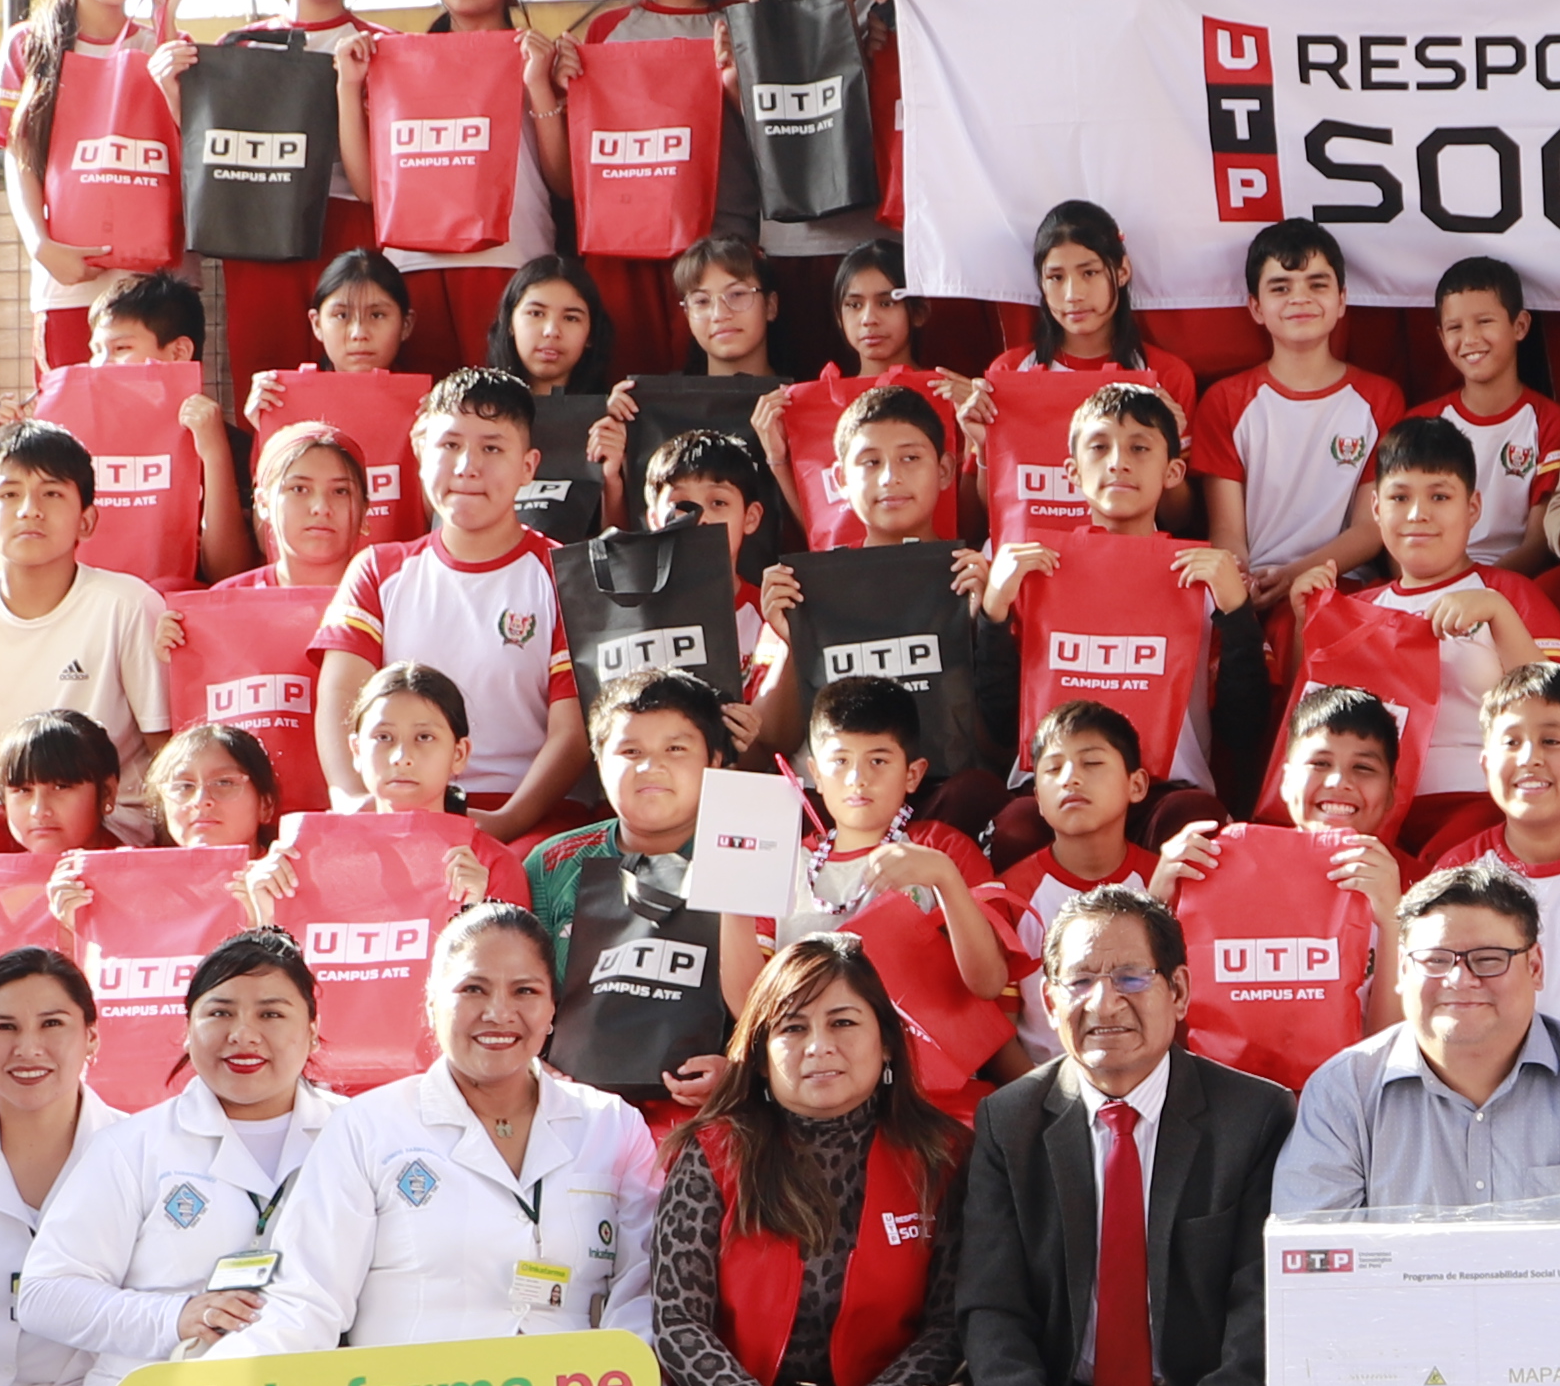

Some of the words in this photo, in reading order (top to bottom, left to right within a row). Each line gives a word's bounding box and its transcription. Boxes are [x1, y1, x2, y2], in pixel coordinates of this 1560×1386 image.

[758, 85, 836, 112] UTP
[765, 123, 815, 135] CAMPUS
[816, 118, 835, 131] ATE
[1216, 29, 1268, 208] UTP
[396, 123, 482, 145] UTP
[80, 143, 164, 165] UTP
[210, 136, 298, 159] UTP
[598, 134, 683, 157] UTP
[400, 157, 450, 168] CAMPUS
[452, 155, 476, 166] ATE
[80, 174, 132, 186] CAMPUS
[134, 176, 158, 187] ATE
[213, 169, 266, 182] CAMPUS
[268, 170, 292, 182] ATE
[602, 168, 652, 178] CAMPUS
[654, 166, 677, 177] ATE
[133, 495, 157, 506] ATE
[524, 500, 549, 511] ATE
[366, 505, 390, 517] ATE
[1030, 506, 1085, 517] CAMPUS
[604, 635, 695, 670] UTP
[832, 643, 931, 676] UTP
[1056, 639, 1158, 665] UTP
[903, 680, 930, 691] ATE
[1061, 677, 1120, 690] CAMPUS
[1122, 679, 1149, 691] ATE
[214, 684, 305, 711] UTP
[274, 717, 299, 729] ATE
[719, 836, 756, 849] UTP
[313, 926, 419, 955] UTP
[598, 944, 696, 975] UTP
[1223, 947, 1331, 973] UTP
[99, 965, 197, 992] UTP
[317, 968, 378, 982] CAMPUS
[380, 966, 410, 979] ATE
[592, 981, 651, 998] CAMPUS
[653, 989, 682, 1001] ATE
[1230, 988, 1295, 1001] CAMPUS
[1298, 988, 1326, 1000] ATE
[101, 1006, 158, 1018] CAMPUS
[160, 1004, 188, 1016] ATE
[1286, 1253, 1349, 1270] UTP
[1403, 1272, 1444, 1282] Programa
[1446, 1271, 1457, 1280] de
[1458, 1270, 1529, 1281] Responsabilidad
[1530, 1269, 1556, 1278] Social
